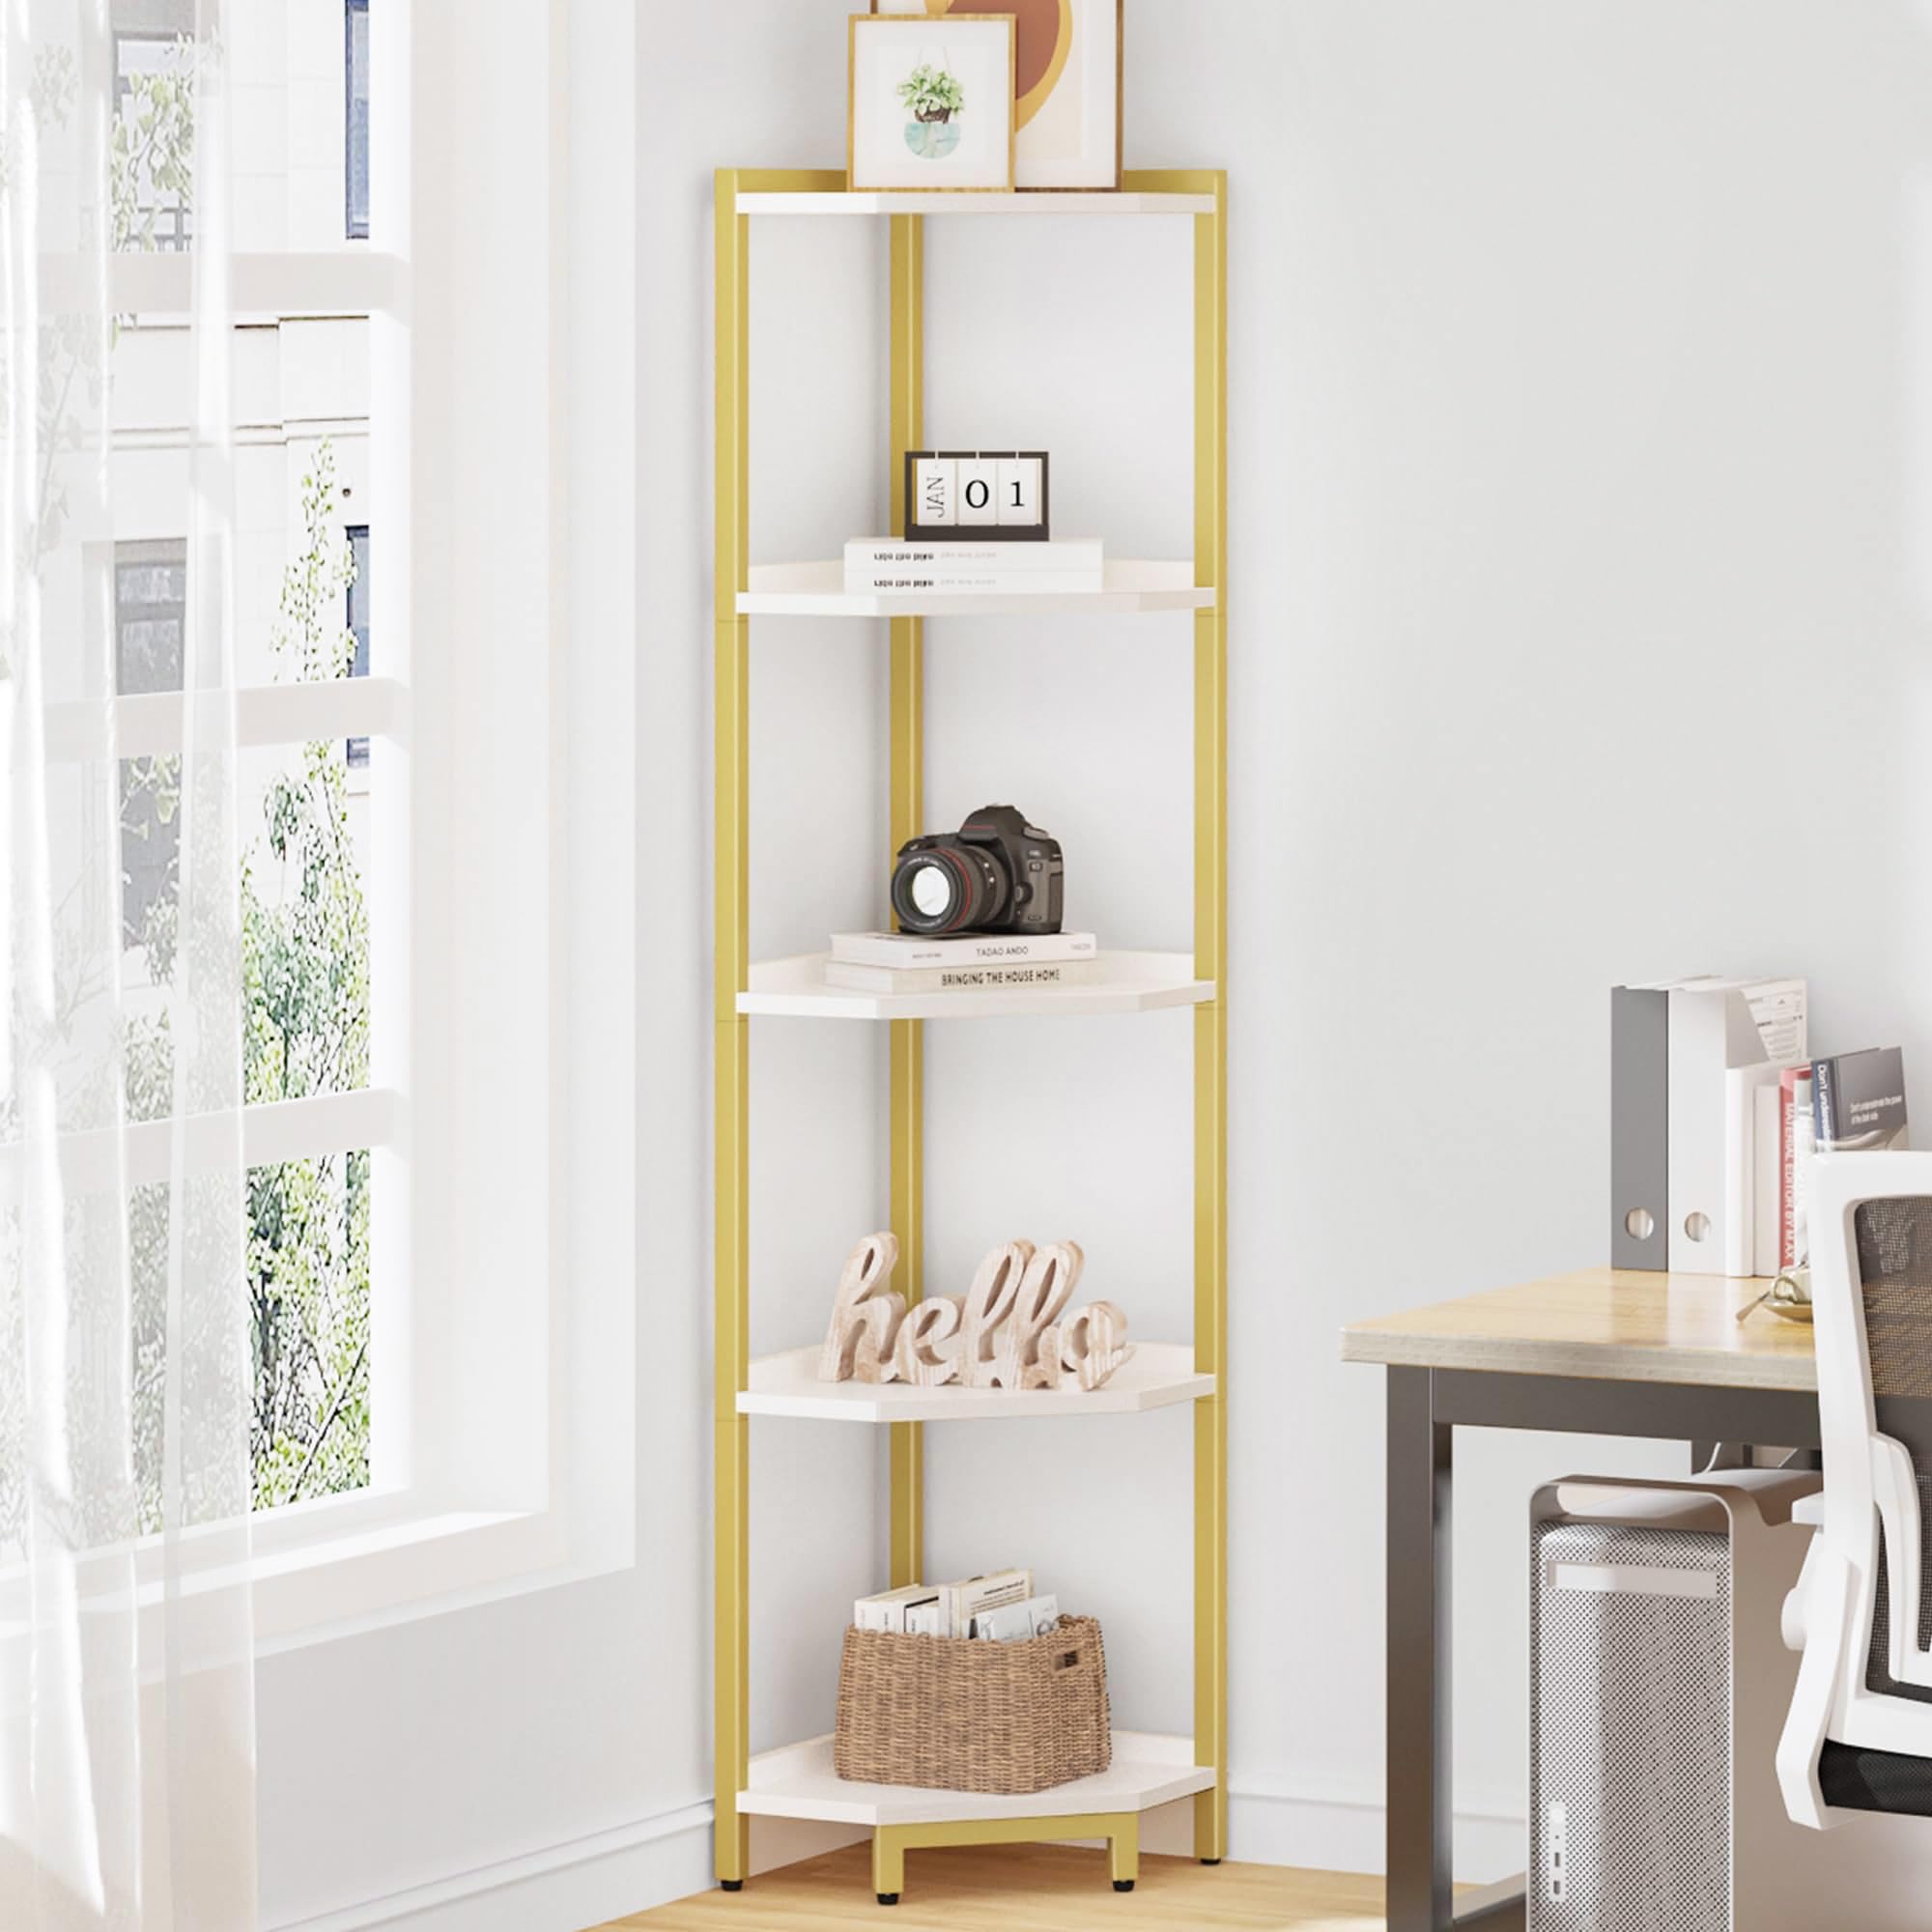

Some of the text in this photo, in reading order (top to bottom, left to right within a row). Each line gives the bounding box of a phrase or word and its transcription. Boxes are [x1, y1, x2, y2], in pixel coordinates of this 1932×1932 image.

[926, 476, 944, 518] JAN
[976, 945, 1029, 957] TADAO ANDO
[941, 968, 1061, 986] BRINGING THE HOUSE HOME
[1784, 1162, 1796, 1208] EDITOR
[818, 1232, 1136, 1391] hello
